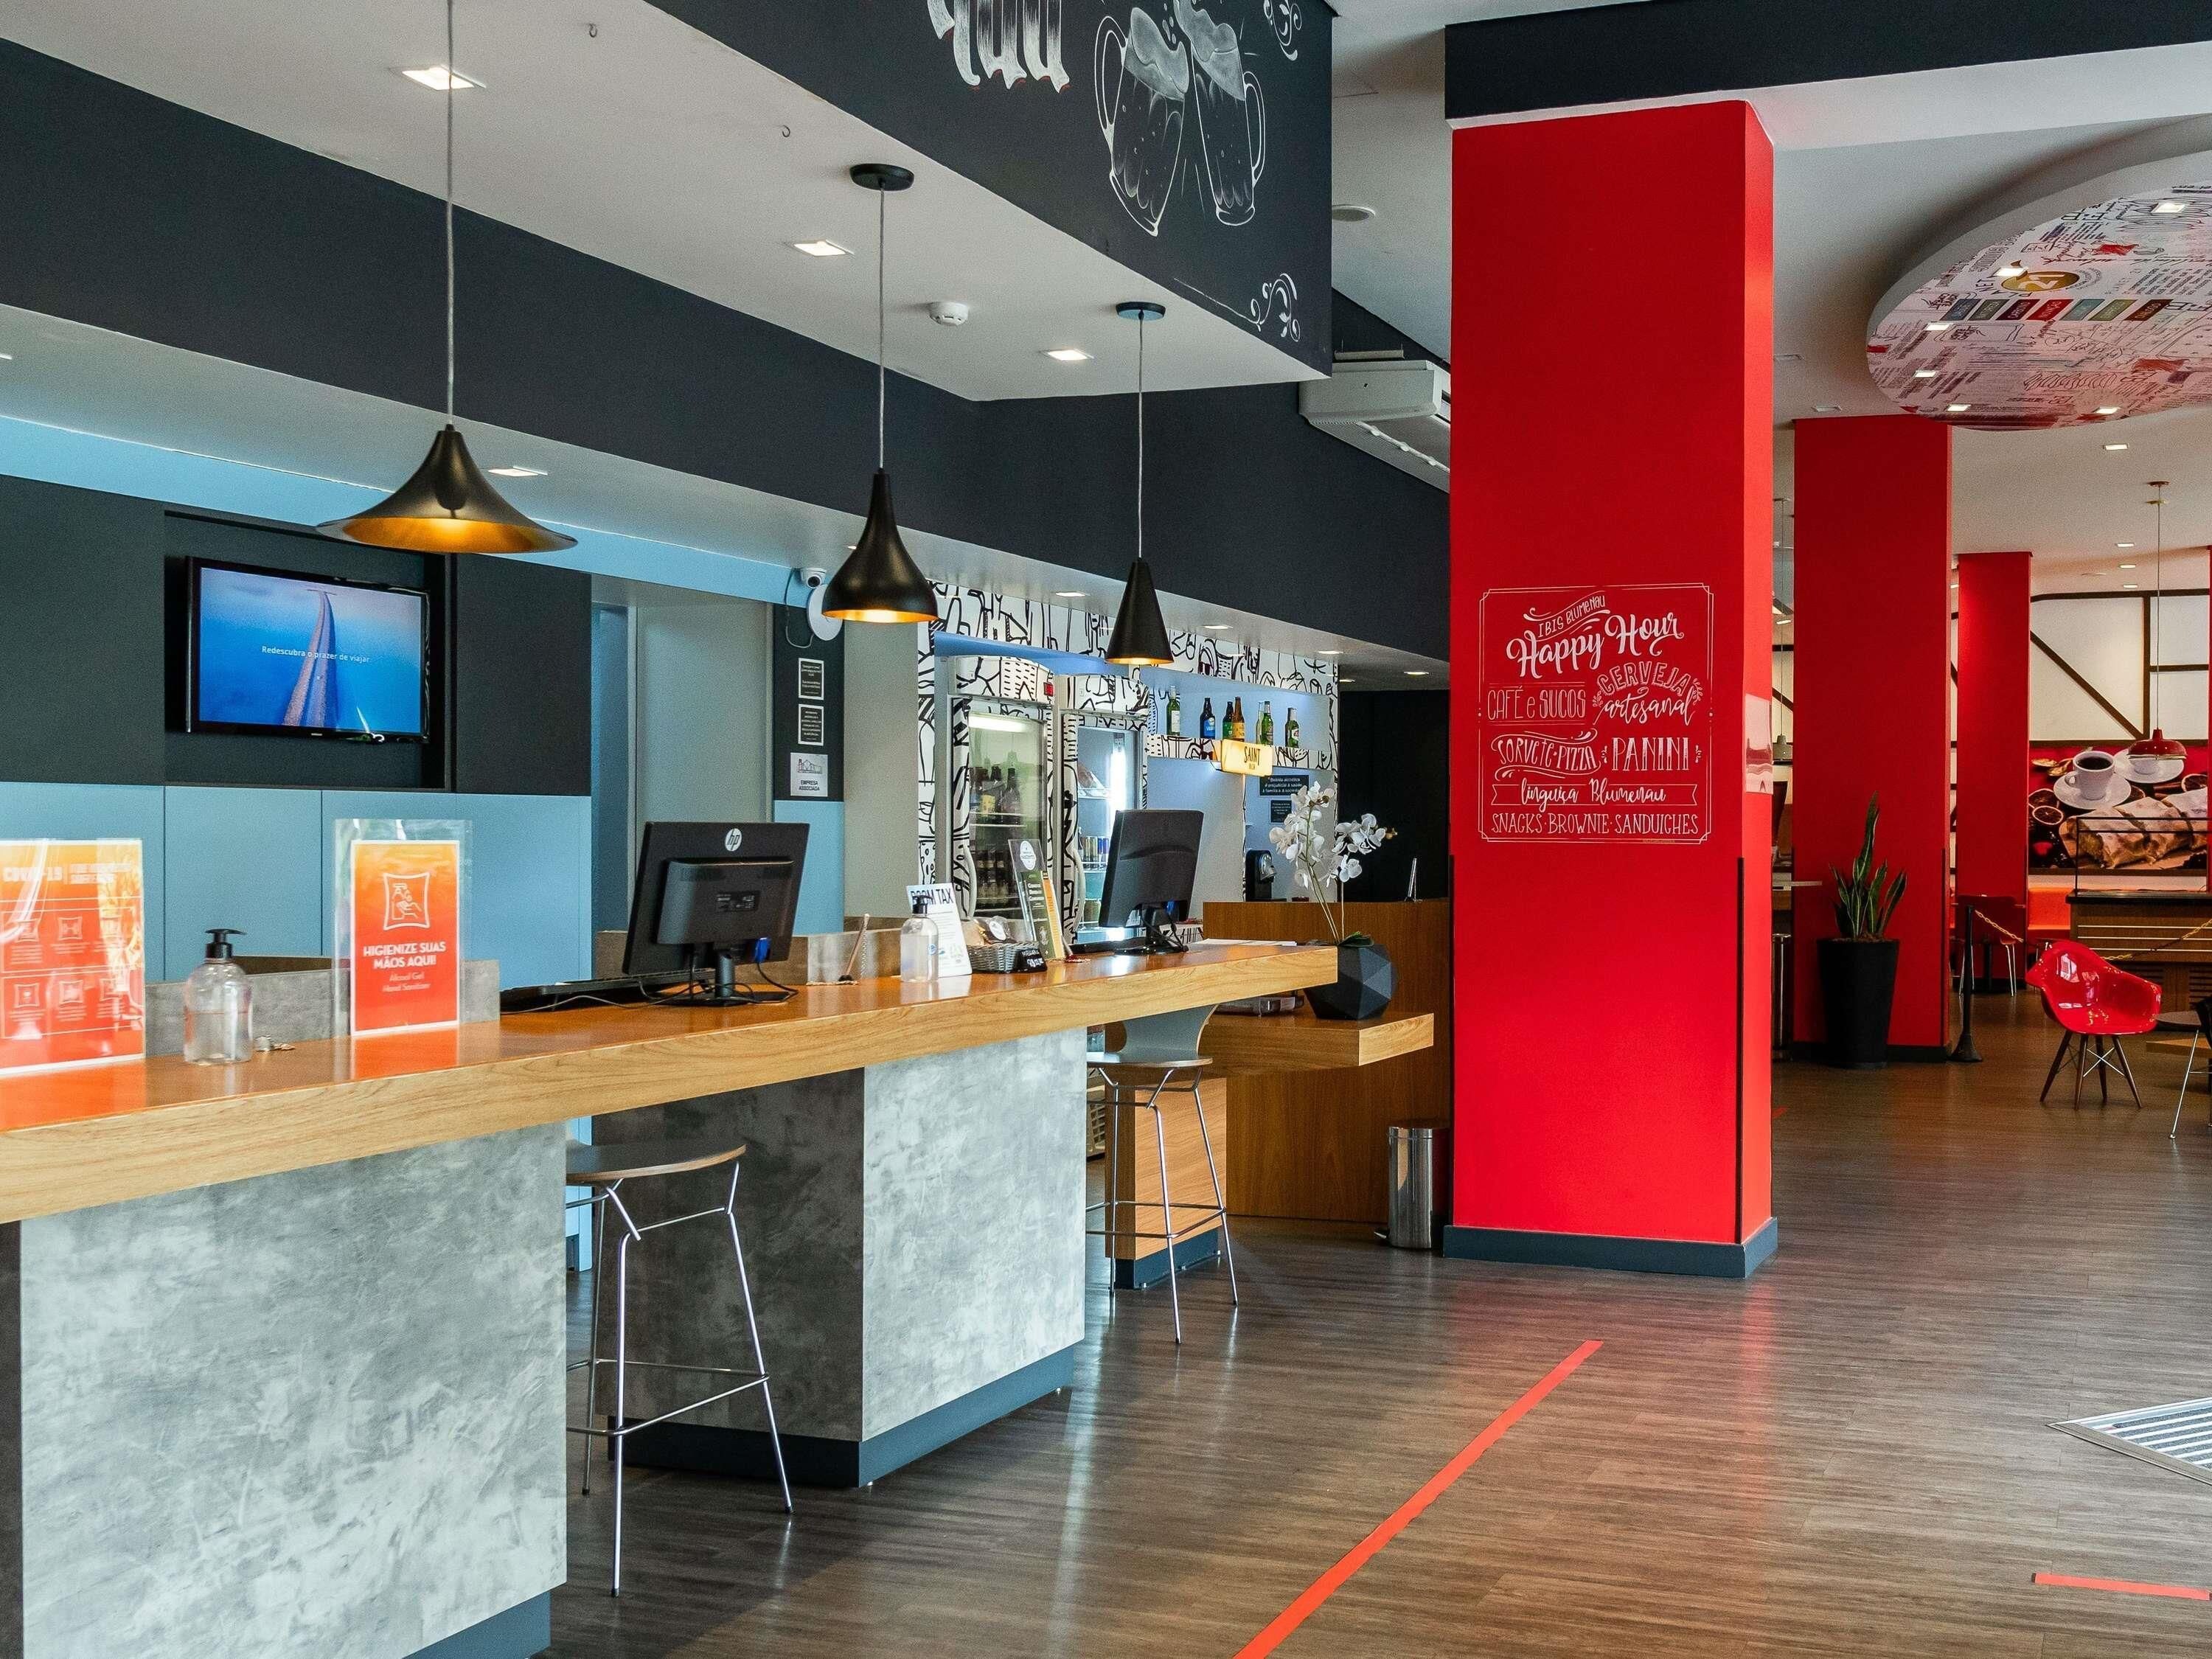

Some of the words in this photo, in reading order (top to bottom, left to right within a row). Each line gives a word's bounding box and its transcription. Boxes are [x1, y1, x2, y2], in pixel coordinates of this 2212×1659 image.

[1537, 616, 1564, 638] IBIS
[262, 645, 306, 657] Redescubra
[314, 651, 337, 659] prazer
[349, 655, 369, 664] viajar
[1506, 630, 1605, 678] Happy
[1604, 612, 1685, 656] Hour
[1597, 661, 1693, 696] CERVEJA
[1487, 686, 1523, 720] CAFÉ
[1526, 696, 1535, 718] e
[1539, 689, 1586, 719] SUCOS
[1593, 686, 1696, 726] artesanal
[1244, 746, 1261, 766] SAINT
[1557, 745, 1598, 771] PIZZA
[1612, 737, 1689, 771] PANINI
[1521, 778, 1579, 813] linguiça
[1589, 778, 1666, 805] Blumenau
[1491, 813, 1543, 834] SNACKS
[1548, 813, 1608, 835] BROWNIE
[1615, 813, 1699, 835] SANDUICHES
[726, 829, 741, 851] hp
[936, 888, 954, 905] TAX
[363, 943, 418, 956] HIGIENIZE
[419, 941, 446, 953] SUAS
[373, 955, 406, 969] MÃOS
